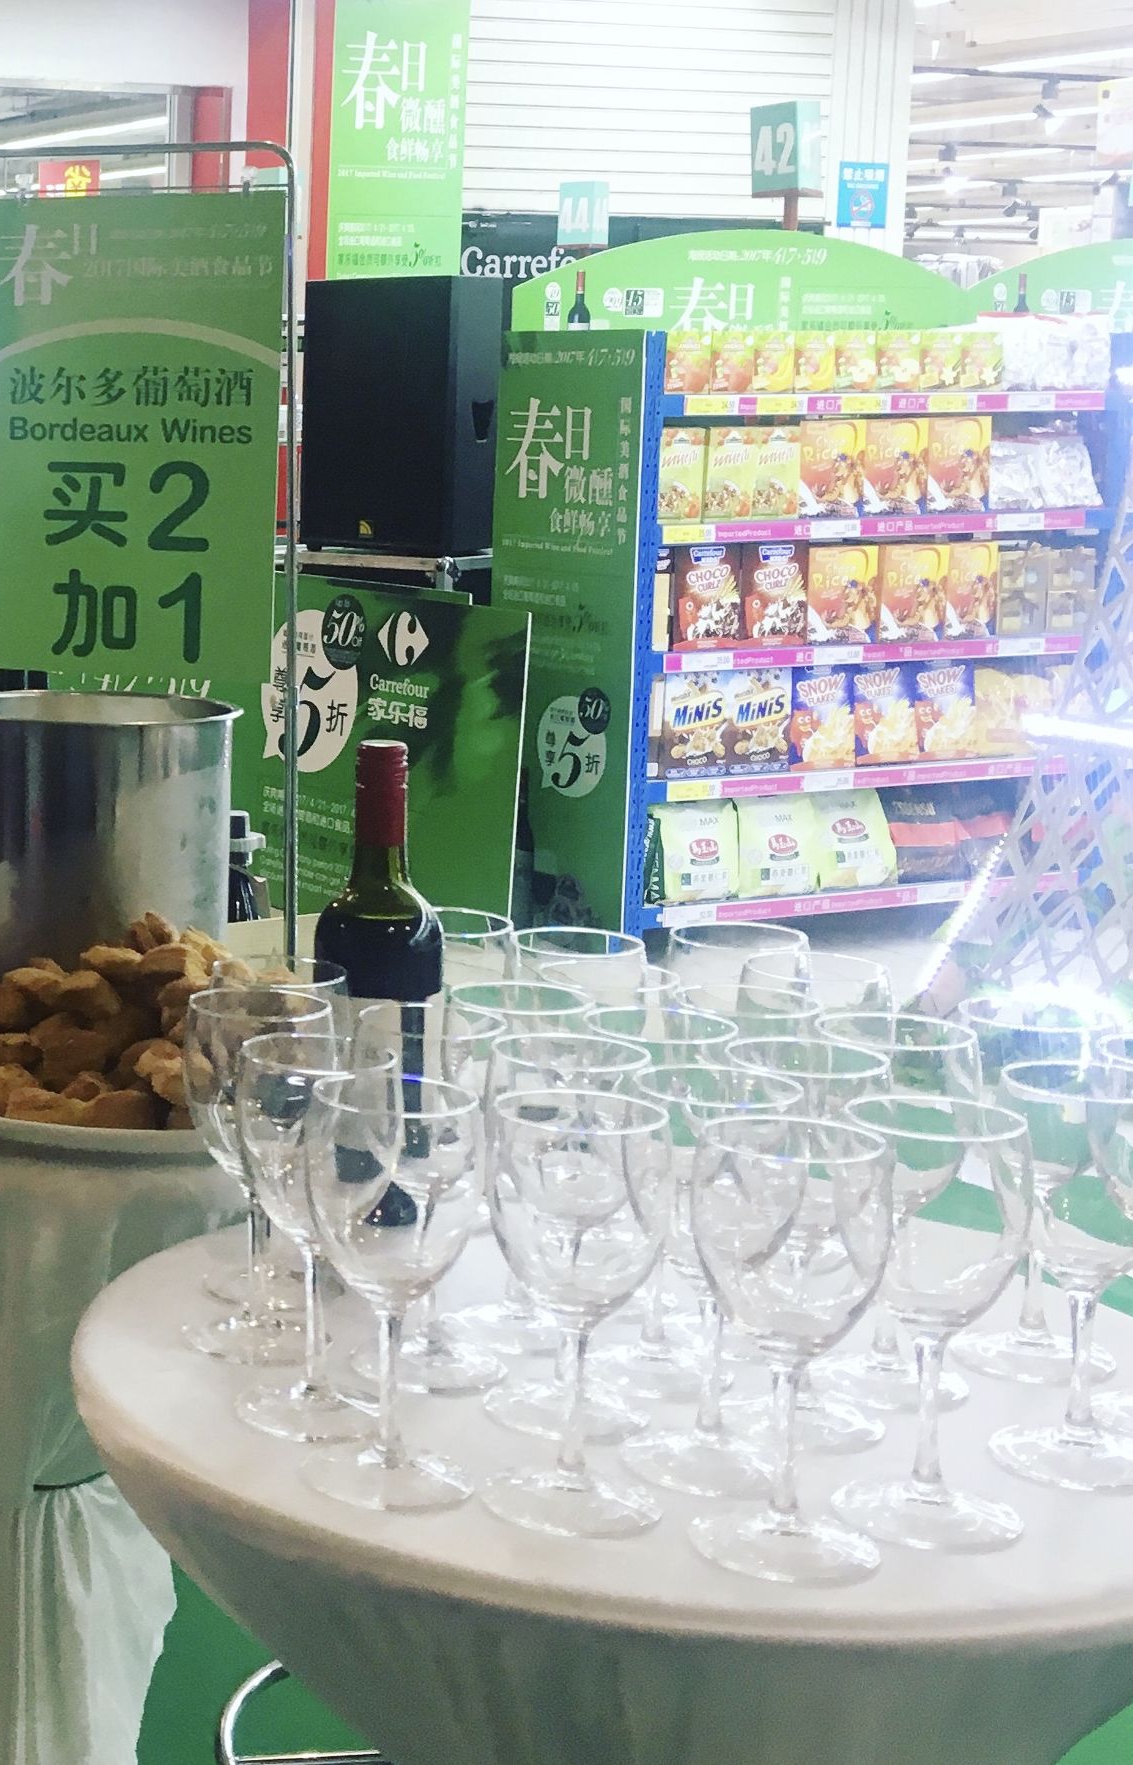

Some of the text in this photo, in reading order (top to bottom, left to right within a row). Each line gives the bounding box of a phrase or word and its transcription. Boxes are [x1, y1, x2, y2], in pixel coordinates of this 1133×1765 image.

[340, 30, 428, 130] 春日
[755, 122, 796, 176] 42
[9, 366, 254, 407] 波尔多葡萄酒
[9, 416, 253, 444] Bordeaux Wines
[504, 396, 592, 499] 春日
[803, 446, 838, 461] Rice
[867, 444, 901, 460] Rice
[931, 442, 964, 457] Rice
[43, 460, 210, 552] 买2
[877, 520, 913, 533] 进口产品
[687, 565, 731, 585] CHOCO
[755, 563, 799, 583] CHOCO
[51, 568, 202, 664] 加1
[369, 673, 430, 699] Carrefour
[797, 673, 845, 698] SNOW
[854, 667, 900, 690] SNOW
[917, 665, 965, 689] SNOW
[807, 692, 838, 706] FLAKES
[928, 684, 956, 698] FLAKES
[326, 699, 348, 736] 折
[367, 697, 429, 730] 家乐福
[551, 730, 590, 788] 5
[585, 753, 600, 775] 折
